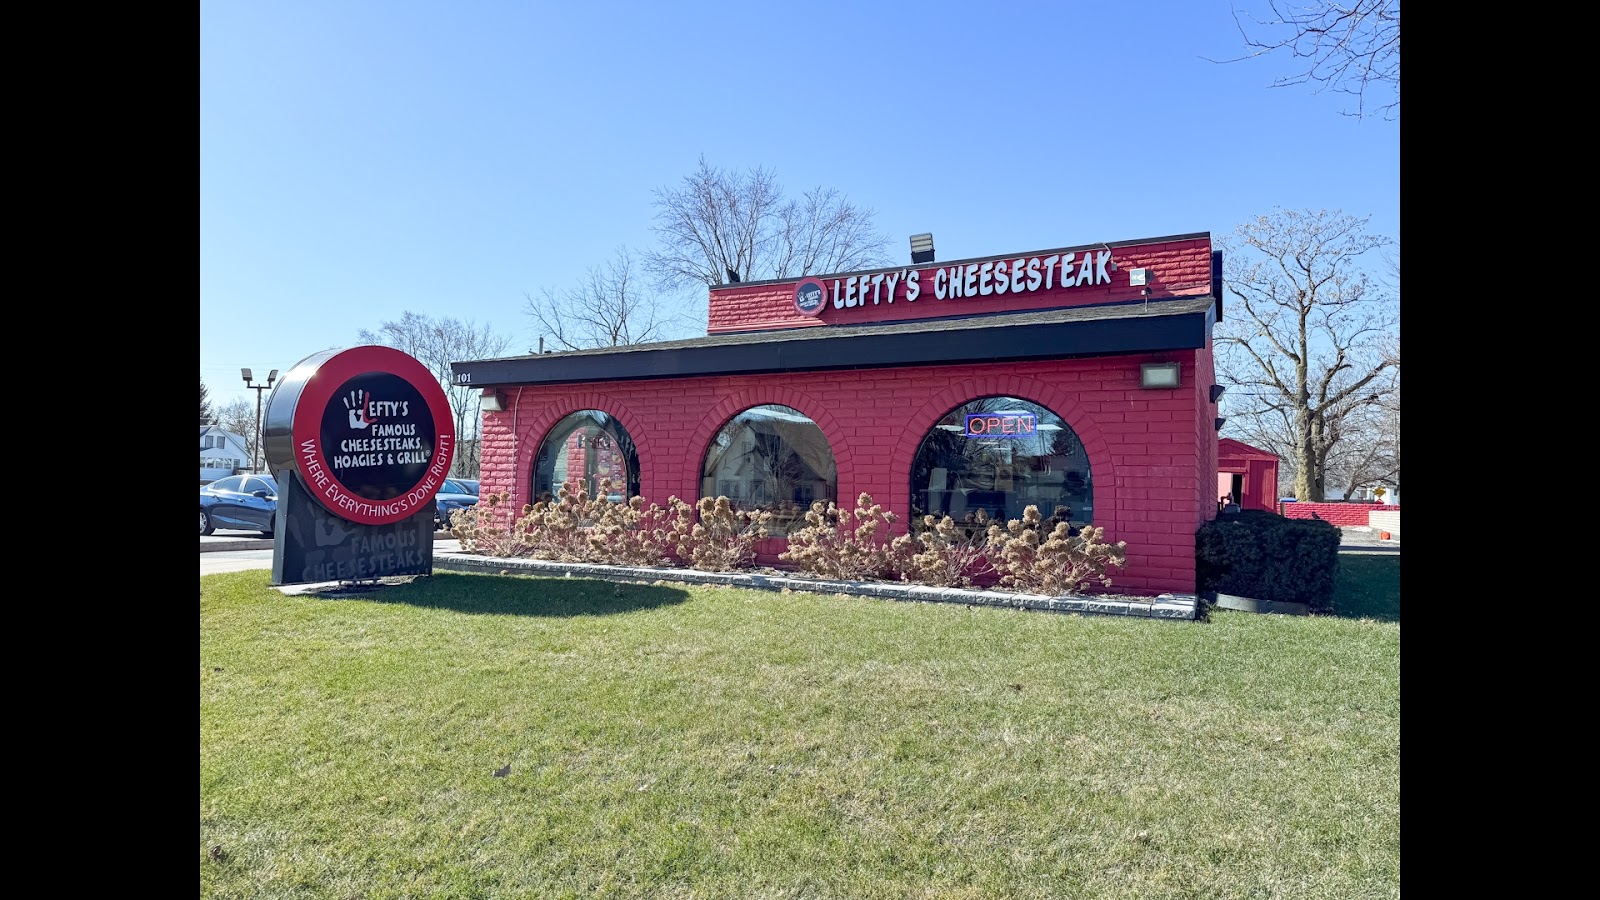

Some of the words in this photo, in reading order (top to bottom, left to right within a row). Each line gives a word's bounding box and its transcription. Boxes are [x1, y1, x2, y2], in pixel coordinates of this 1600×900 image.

[833, 270, 920, 309] LEFTY'S
[934, 250, 1112, 300] CHEESESTEAK
[457, 372, 471, 383] 101
[371, 423, 416, 437] FAMOUS
[969, 417, 1032, 434] OPEN
[340, 437, 423, 452] CHEESESTEAKS,
[334, 453, 384, 469] HOAGIES
[387, 453, 394, 465] &
[300, 439, 329, 489] WHERE
[325, 483, 408, 517] EVERYTHING'S
[407, 475, 437, 506] DONE
[430, 434, 451, 477] RIGHT!
[351, 529, 416, 554] FAMOUS
